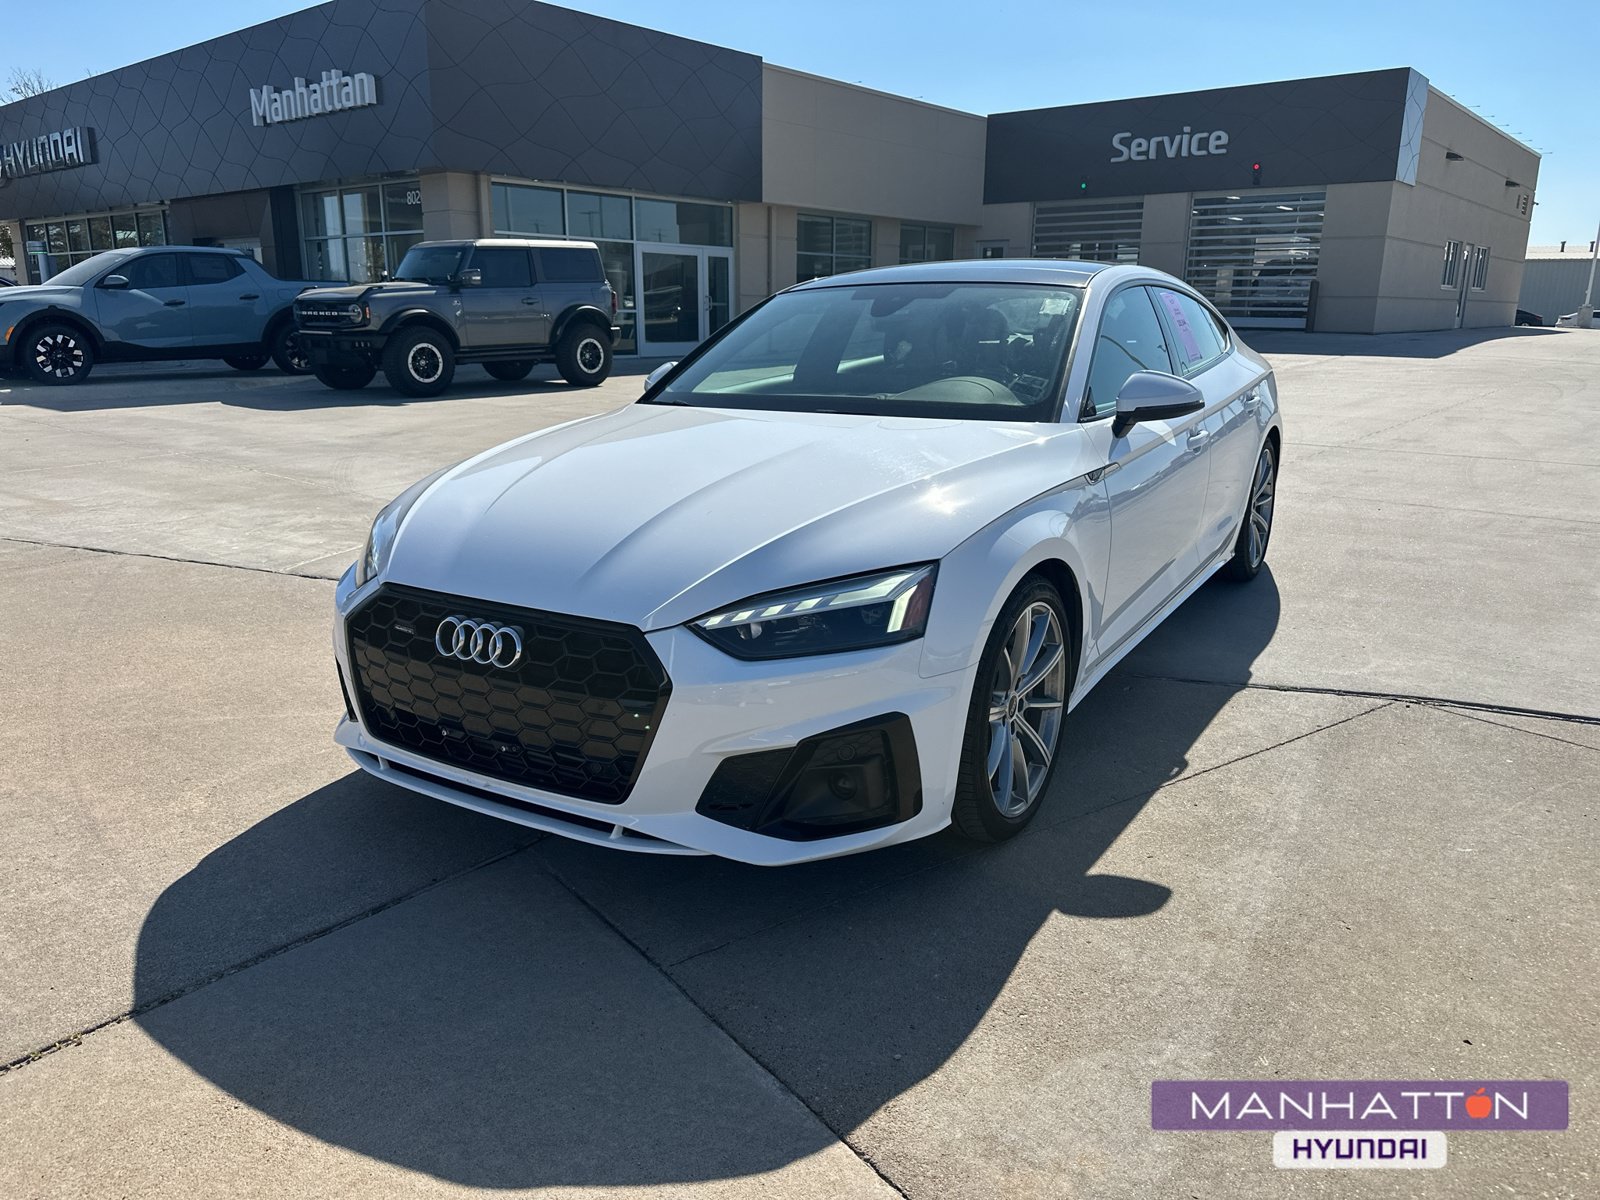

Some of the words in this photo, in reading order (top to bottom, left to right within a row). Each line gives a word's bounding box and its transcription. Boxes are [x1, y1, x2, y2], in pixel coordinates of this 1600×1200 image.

[250, 69, 376, 126] Manhattan
[3, 126, 87, 178] HYUNDAI
[1110, 126, 1229, 163] Service
